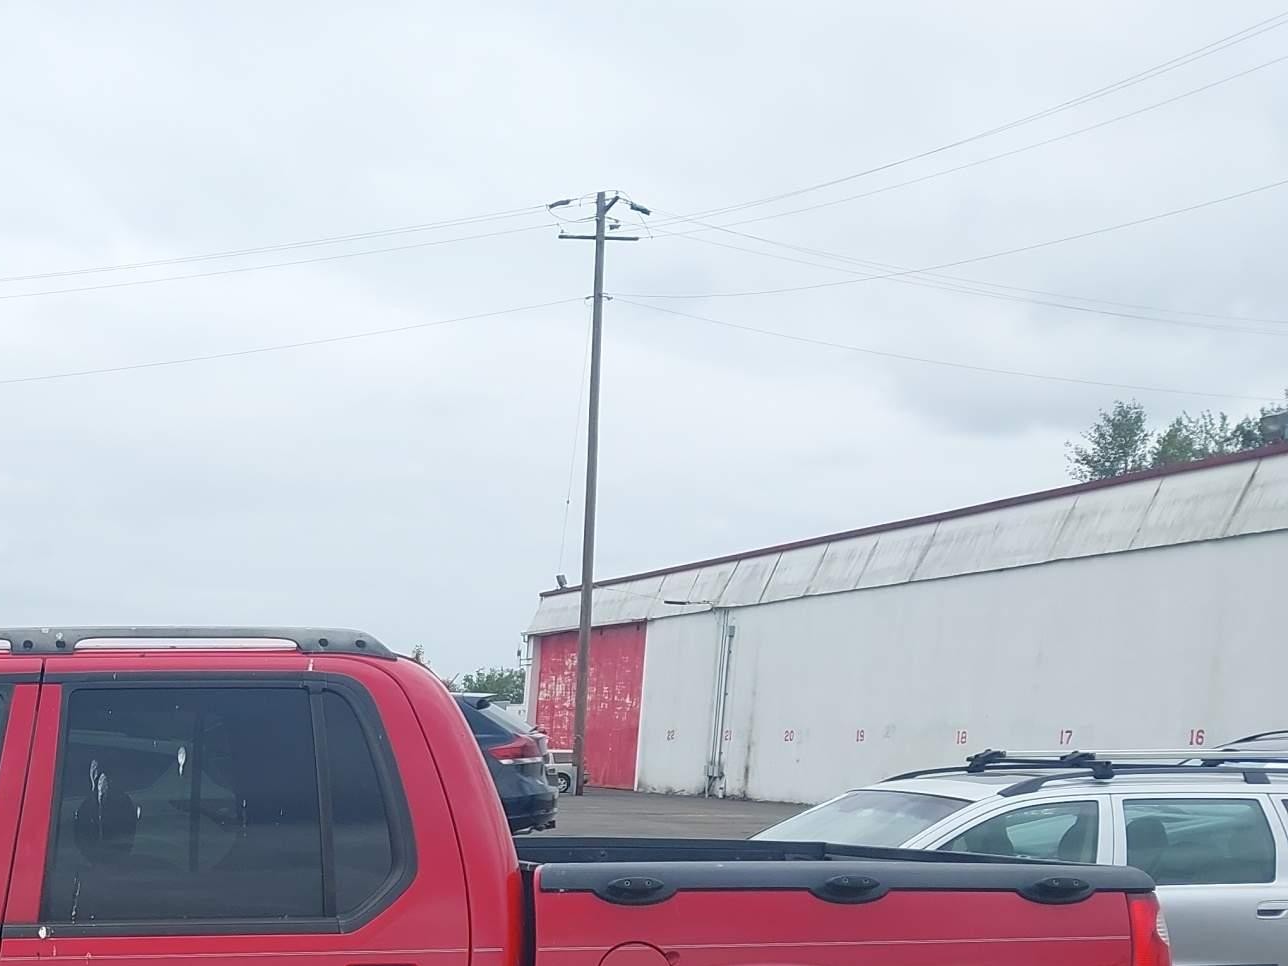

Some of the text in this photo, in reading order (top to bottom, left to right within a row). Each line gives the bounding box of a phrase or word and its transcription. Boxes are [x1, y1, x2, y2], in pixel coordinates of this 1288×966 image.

[724, 729, 732, 741] 21
[784, 729, 794, 741] 20
[855, 729, 865, 742] 19
[956, 730, 967, 745] 18
[1060, 729, 1073, 745] 17
[1189, 729, 1205, 746] 16
